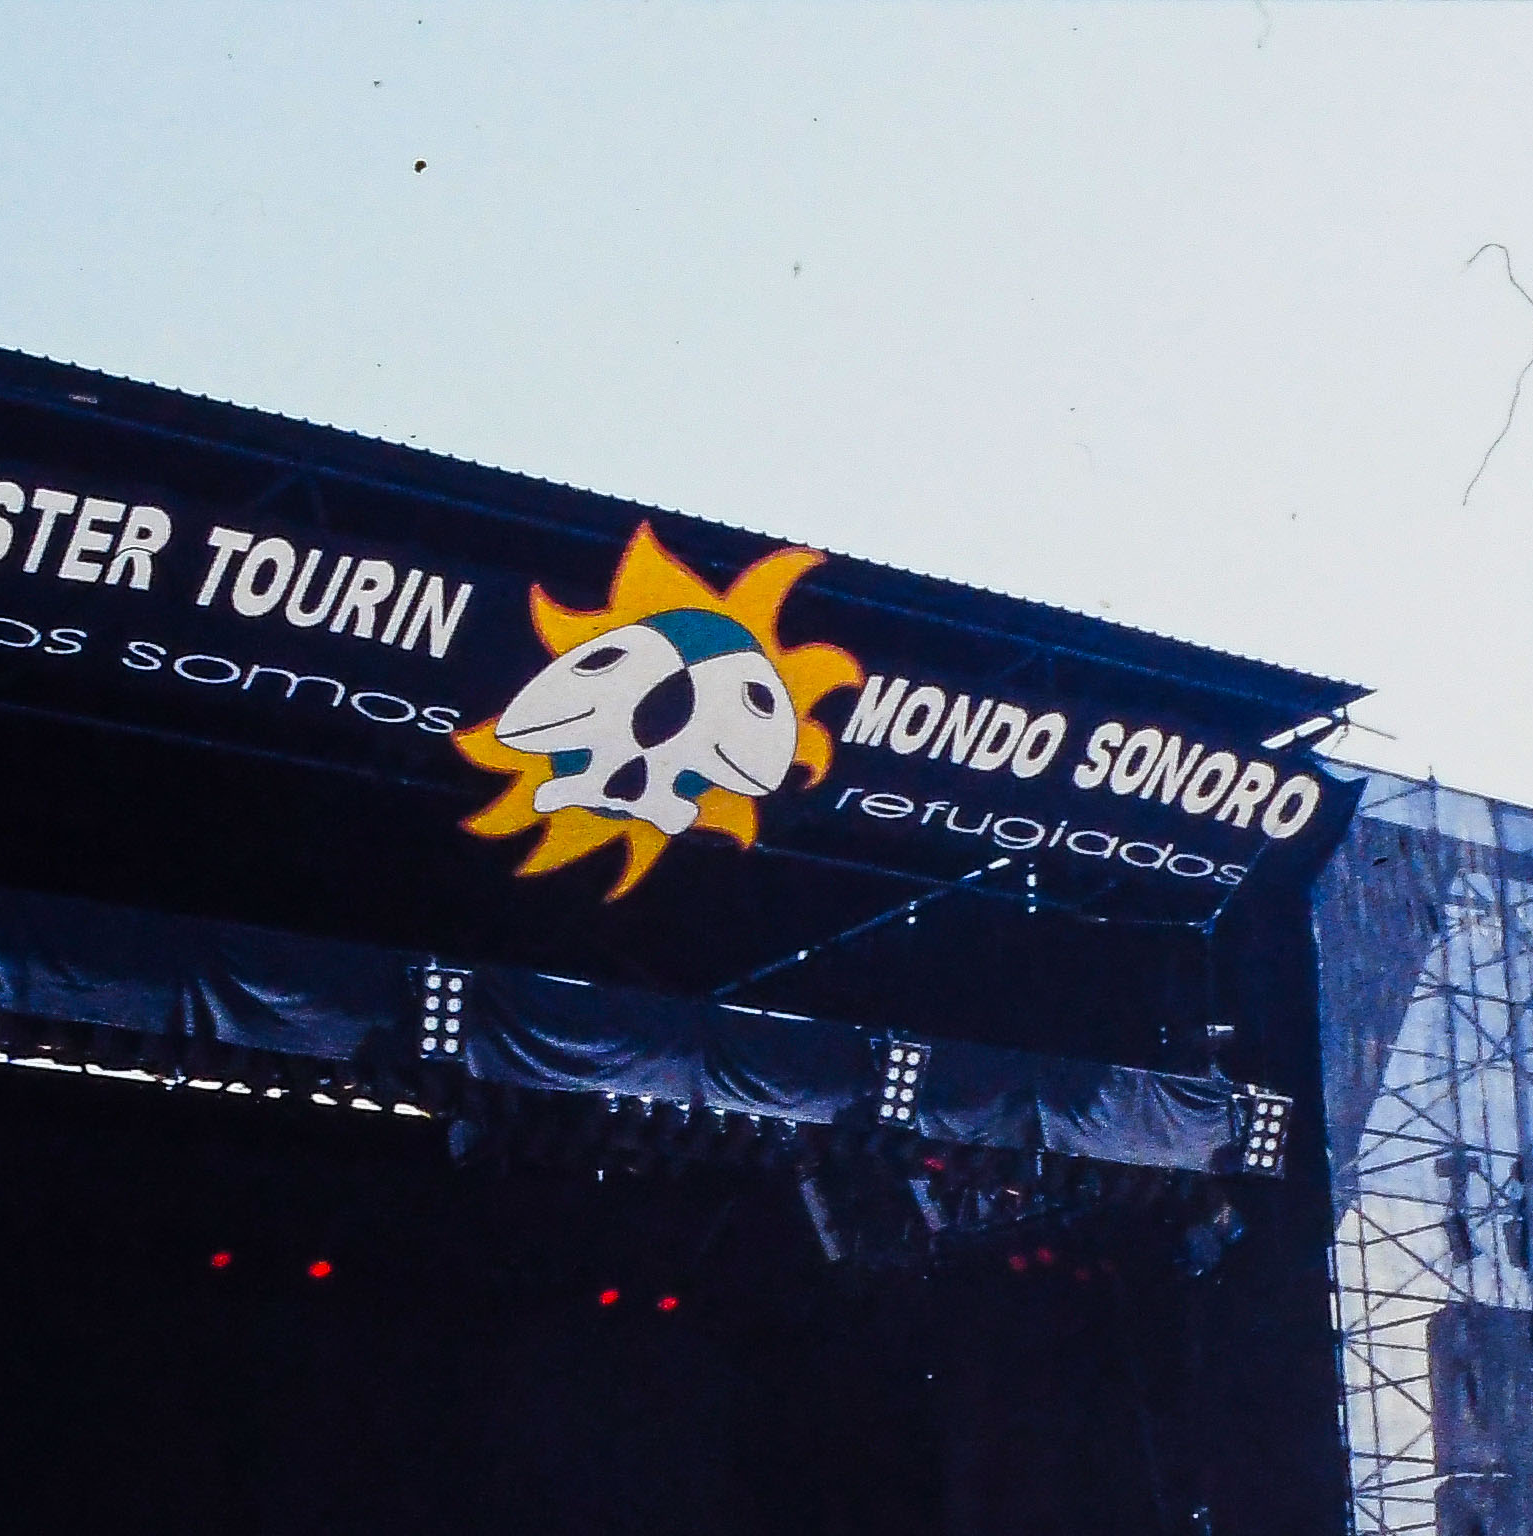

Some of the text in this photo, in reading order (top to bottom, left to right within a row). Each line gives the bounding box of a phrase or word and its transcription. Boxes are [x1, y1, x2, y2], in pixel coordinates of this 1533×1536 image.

[194, 525, 475, 660] TOURIN
[120, 640, 463, 736] somos
[832, 783, 1250, 887] refugiados
[840, 674, 1323, 841] MONDO SONORO
